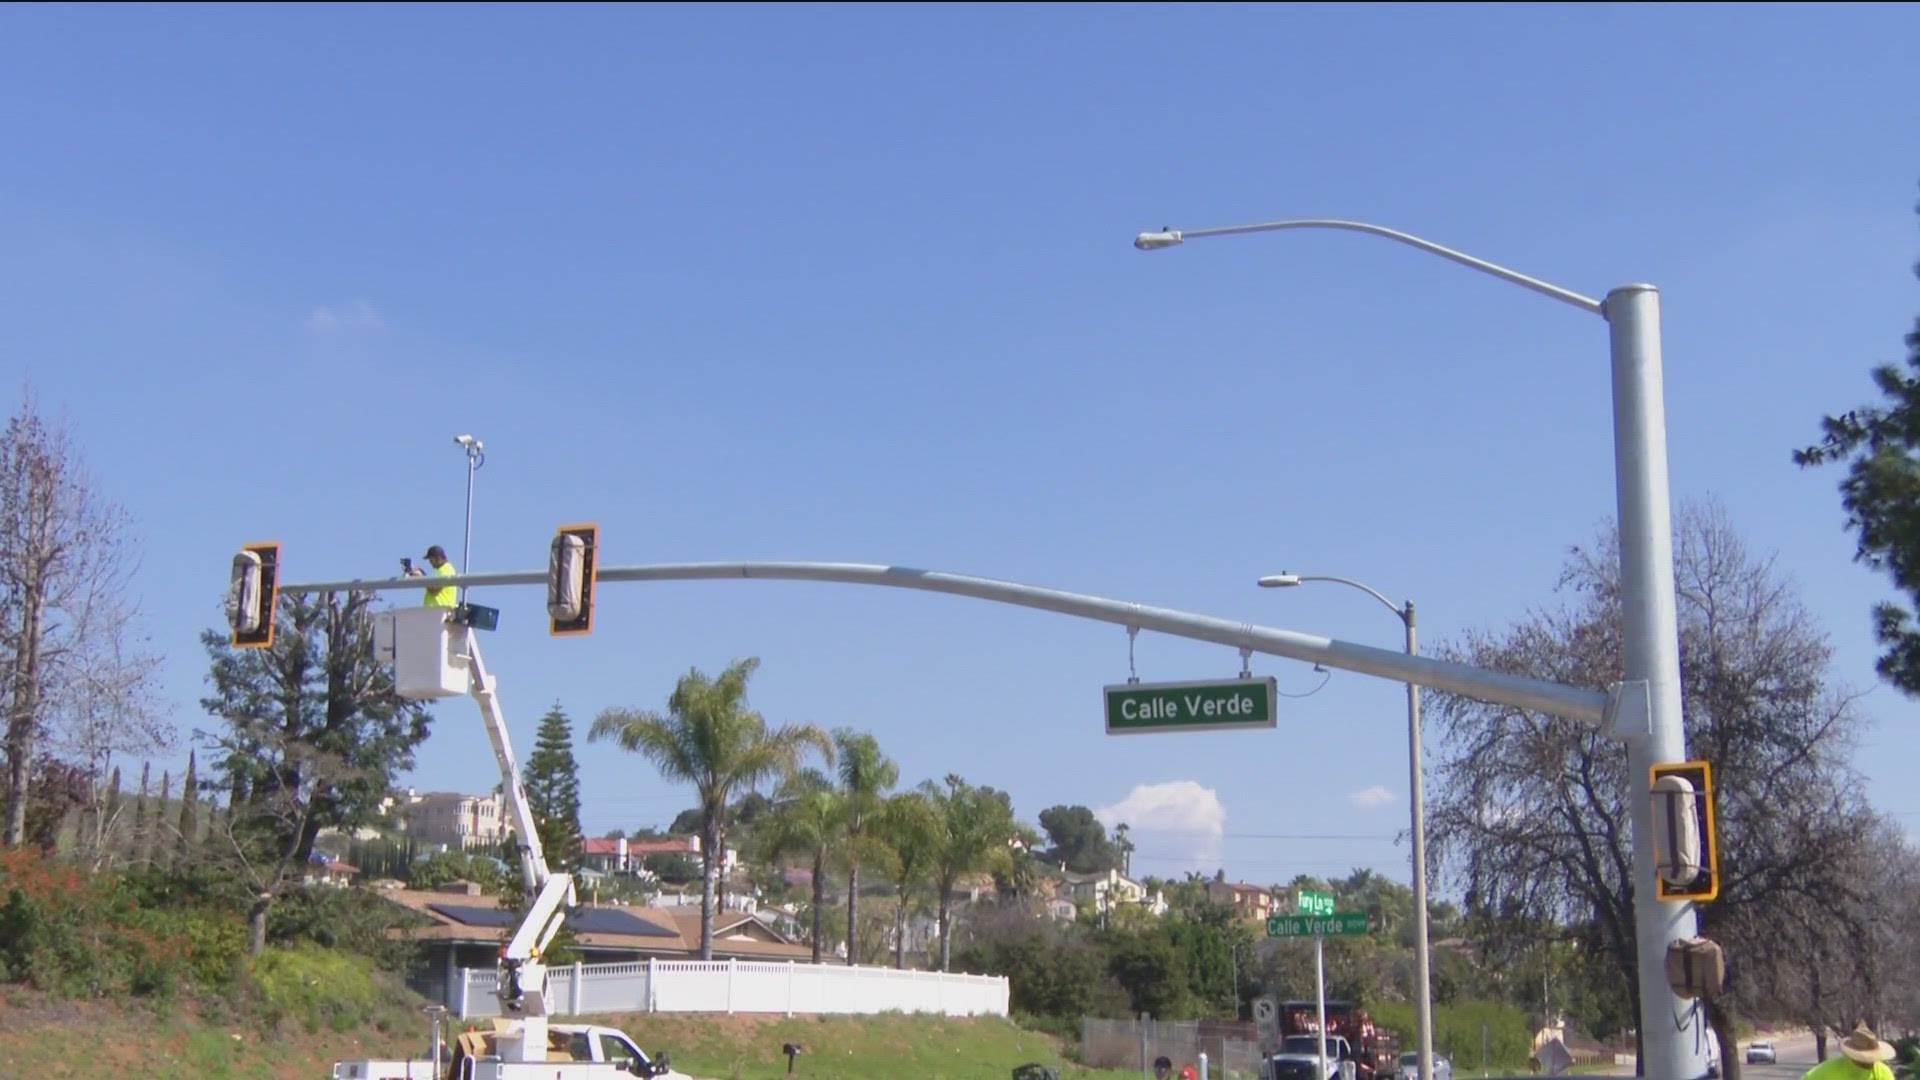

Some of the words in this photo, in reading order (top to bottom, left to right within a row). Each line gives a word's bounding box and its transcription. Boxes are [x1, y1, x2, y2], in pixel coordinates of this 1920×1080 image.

[1121, 696, 1177, 720] Calle
[1184, 693, 1254, 717] Verde
[1268, 919, 1300, 935] Calle
[1304, 918, 1343, 933] Verde
